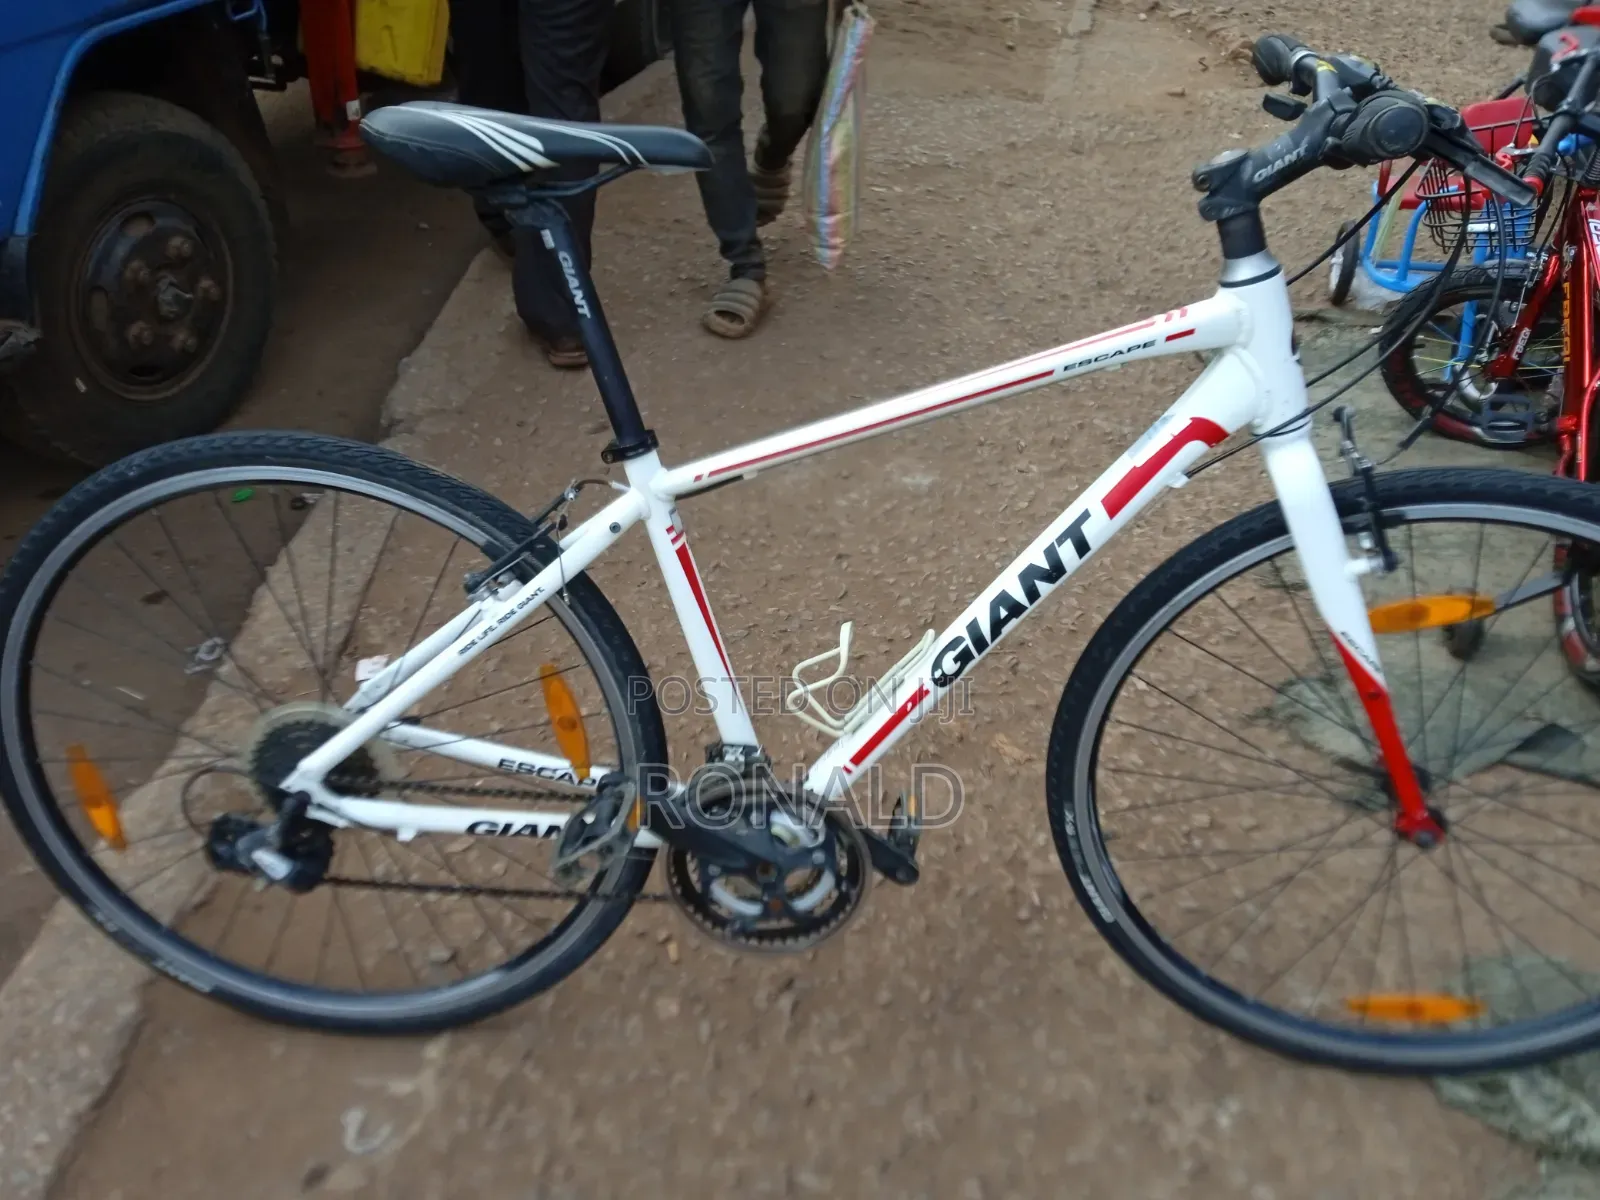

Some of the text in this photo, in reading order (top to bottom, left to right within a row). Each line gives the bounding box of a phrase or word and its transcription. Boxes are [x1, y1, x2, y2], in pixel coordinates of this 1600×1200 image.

[1253, 144, 1308, 183] GIANT
[557, 251, 591, 319] GIANT
[1063, 339, 1157, 372] ESCAPE
[497, 608, 517, 624] RIDE
[517, 586, 545, 610] GIANT
[930, 507, 1092, 688] GIANT
[497, 758, 597, 786] ESCAP
[465, 820, 562, 840] GIAN
